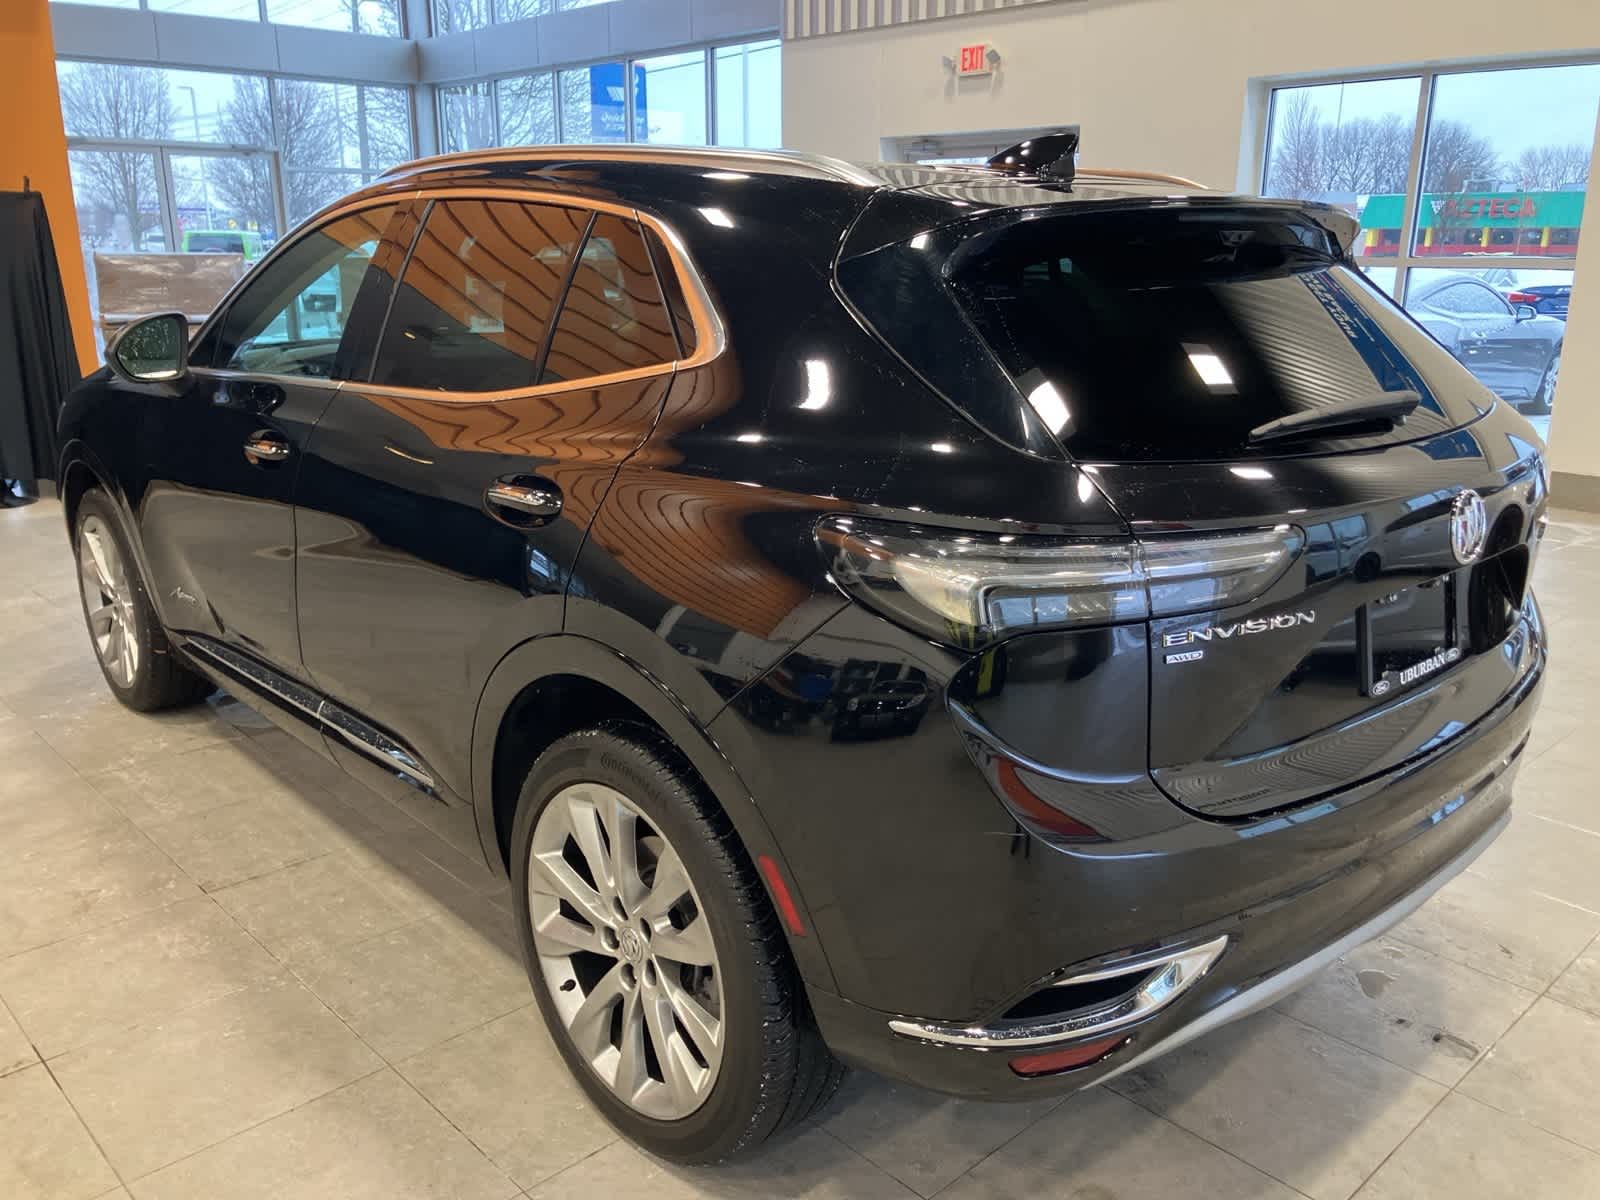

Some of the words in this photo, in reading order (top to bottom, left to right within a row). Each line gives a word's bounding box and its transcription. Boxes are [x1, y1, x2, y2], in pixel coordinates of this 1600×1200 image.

[962, 46, 985, 71] EXIT
[1163, 610, 1315, 647] ENVISION
[1167, 652, 1202, 663] AWD
